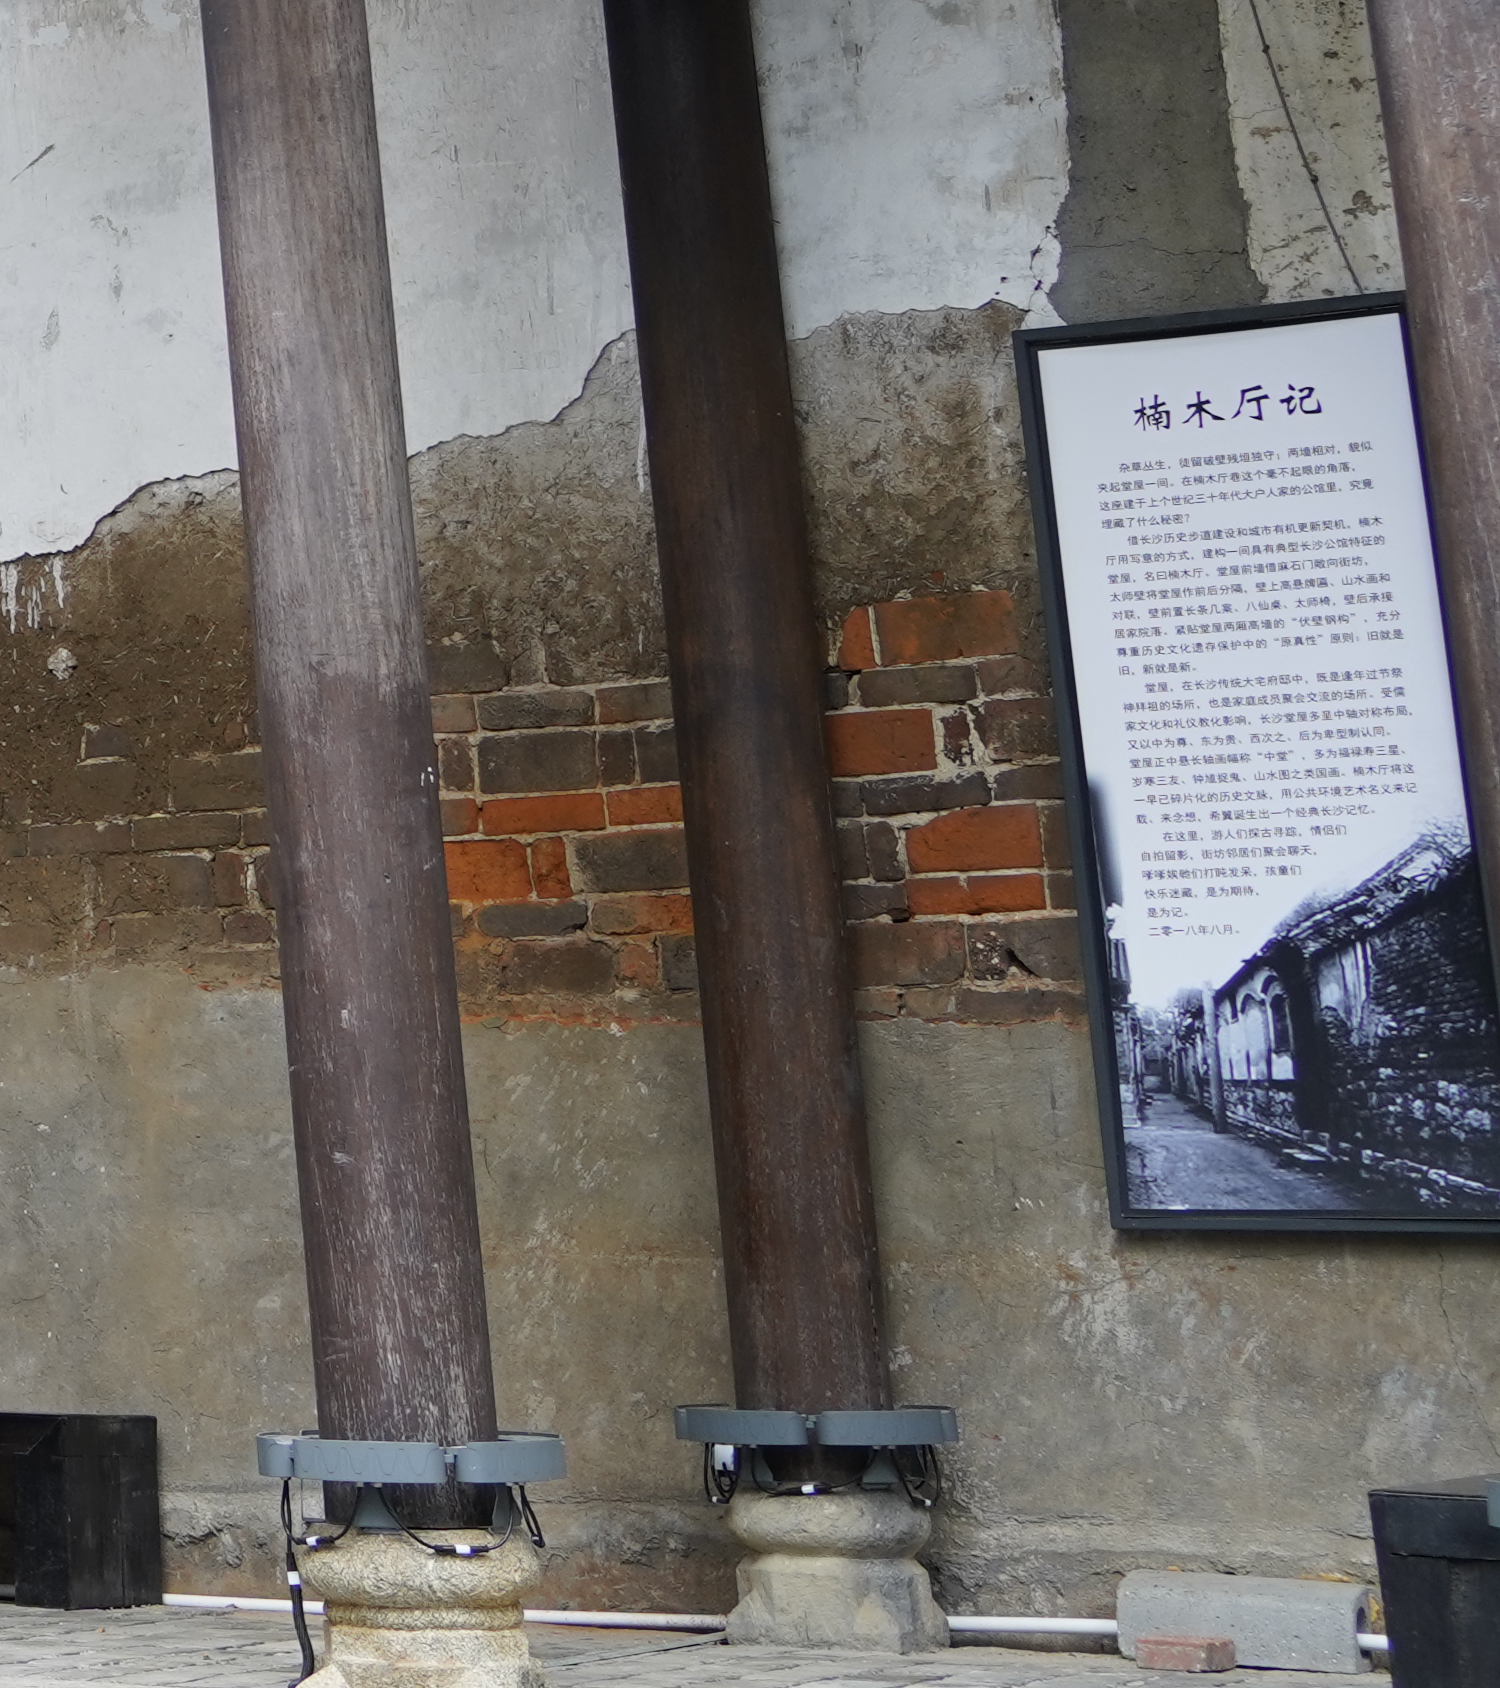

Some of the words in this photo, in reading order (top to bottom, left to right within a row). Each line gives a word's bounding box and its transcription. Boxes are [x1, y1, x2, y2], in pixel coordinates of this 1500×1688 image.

[1133, 383, 1323, 431] 楠木厅记
[1100, 513, 1190, 529] 埋藏了什么秘密？
[1146, 906, 1188, 918] 是为记。
[1148, 923, 1239, 937] 二零一八年八月。
